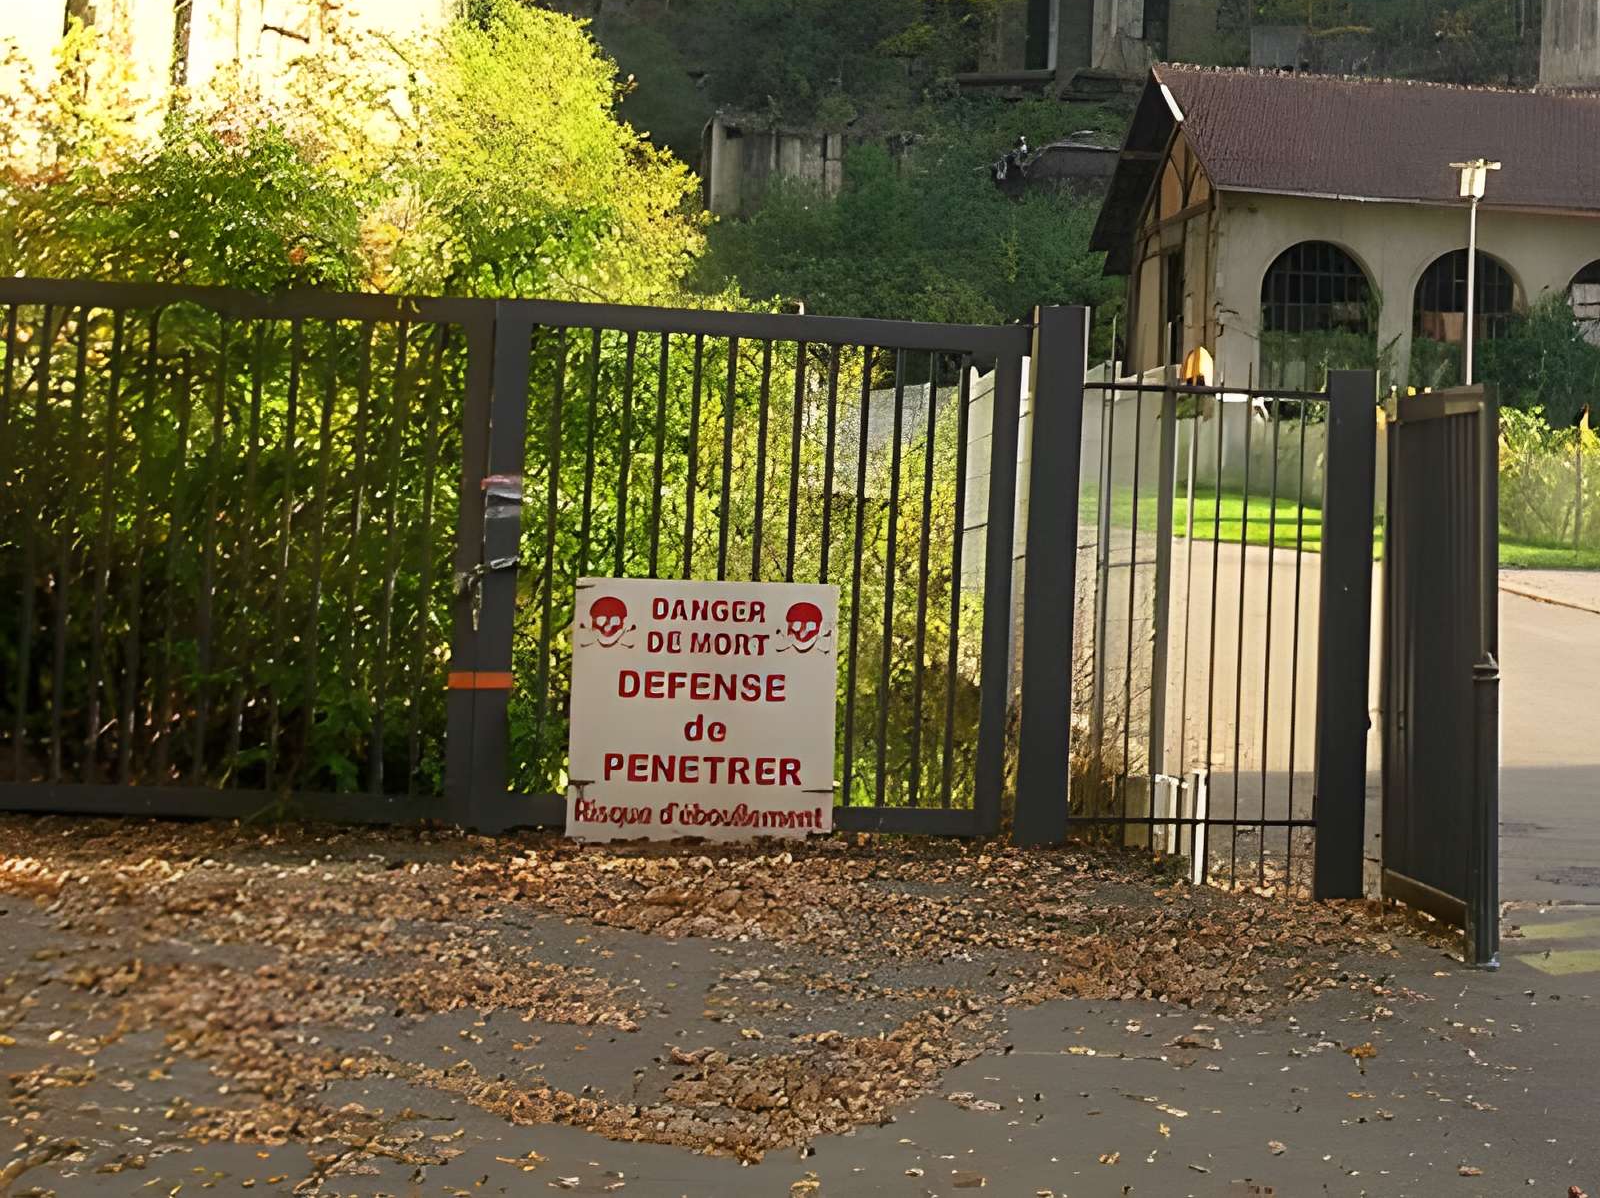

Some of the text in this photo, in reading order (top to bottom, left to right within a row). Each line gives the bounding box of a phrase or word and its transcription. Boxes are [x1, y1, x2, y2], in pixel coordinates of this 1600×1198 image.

[652, 597, 766, 623] DANGER
[647, 631, 770, 656] DE MORT
[618, 670, 786, 702] DEFENSE
[684, 714, 727, 742] de
[604, 753, 802, 787] PENETRER
